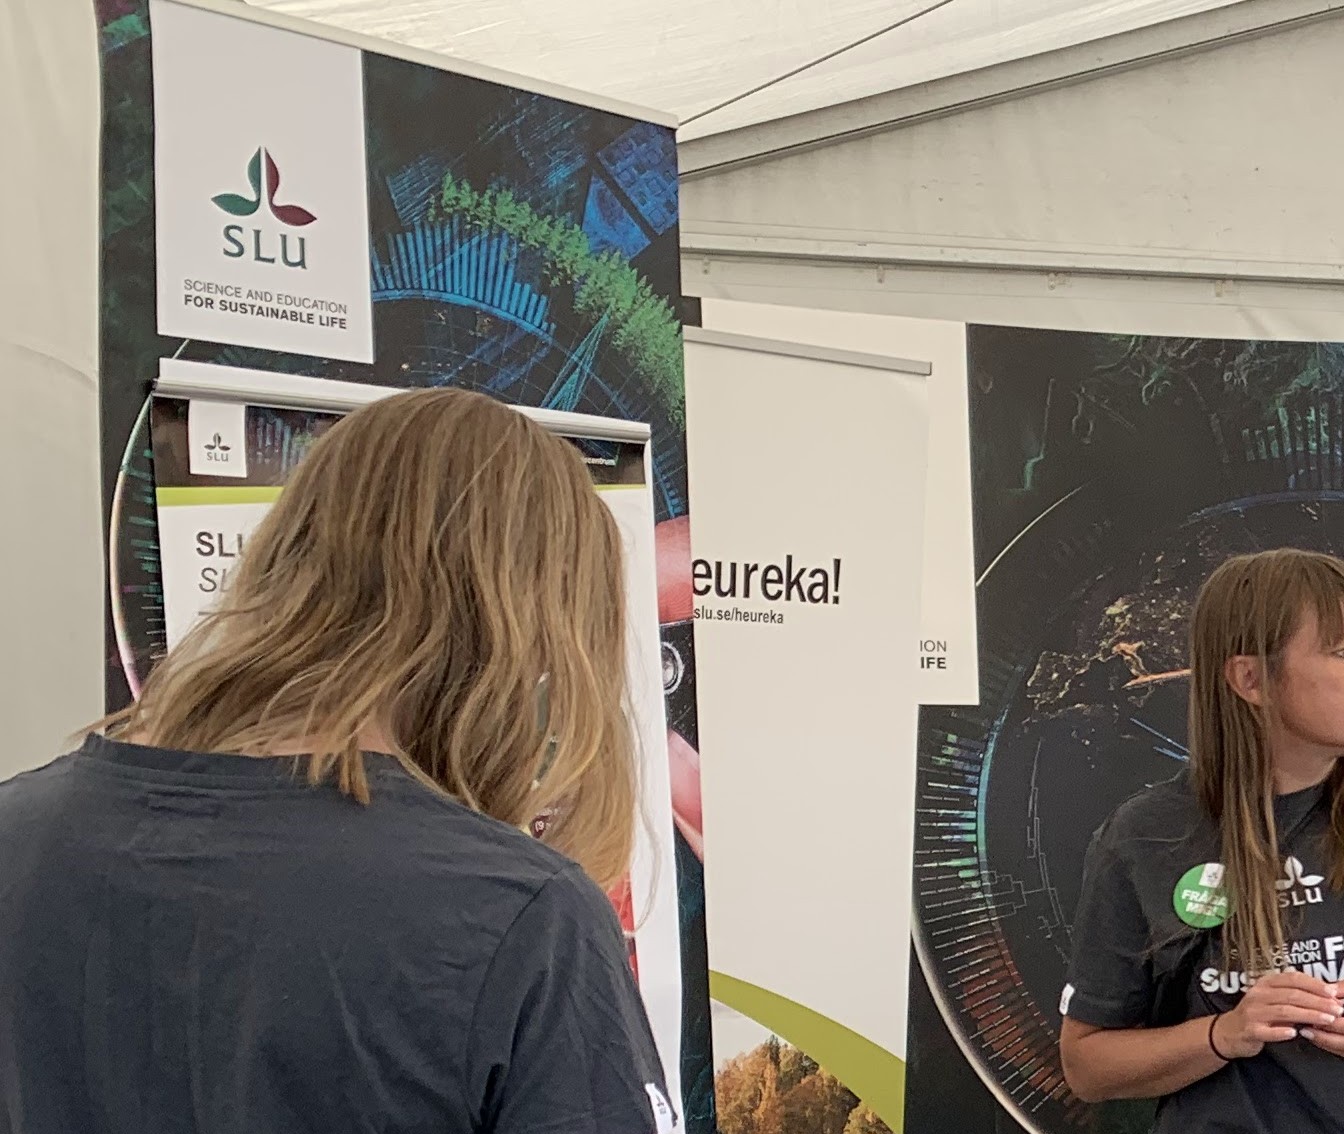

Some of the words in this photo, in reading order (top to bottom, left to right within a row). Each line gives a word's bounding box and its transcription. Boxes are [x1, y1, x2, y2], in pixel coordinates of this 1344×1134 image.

[223, 224, 307, 270] SLU
[184, 279, 242, 298] SCIENCE
[246, 289, 273, 303] AND
[277, 293, 347, 314] EDUCATION
[184, 294, 214, 310] FOR
[219, 300, 314, 324] SUSTAINABLE
[319, 314, 347, 329] LIFE
[206, 451, 229, 462] SLU
[693, 605, 784, 624] slu.se/heureka
[1292, 939, 1320, 954] AND
